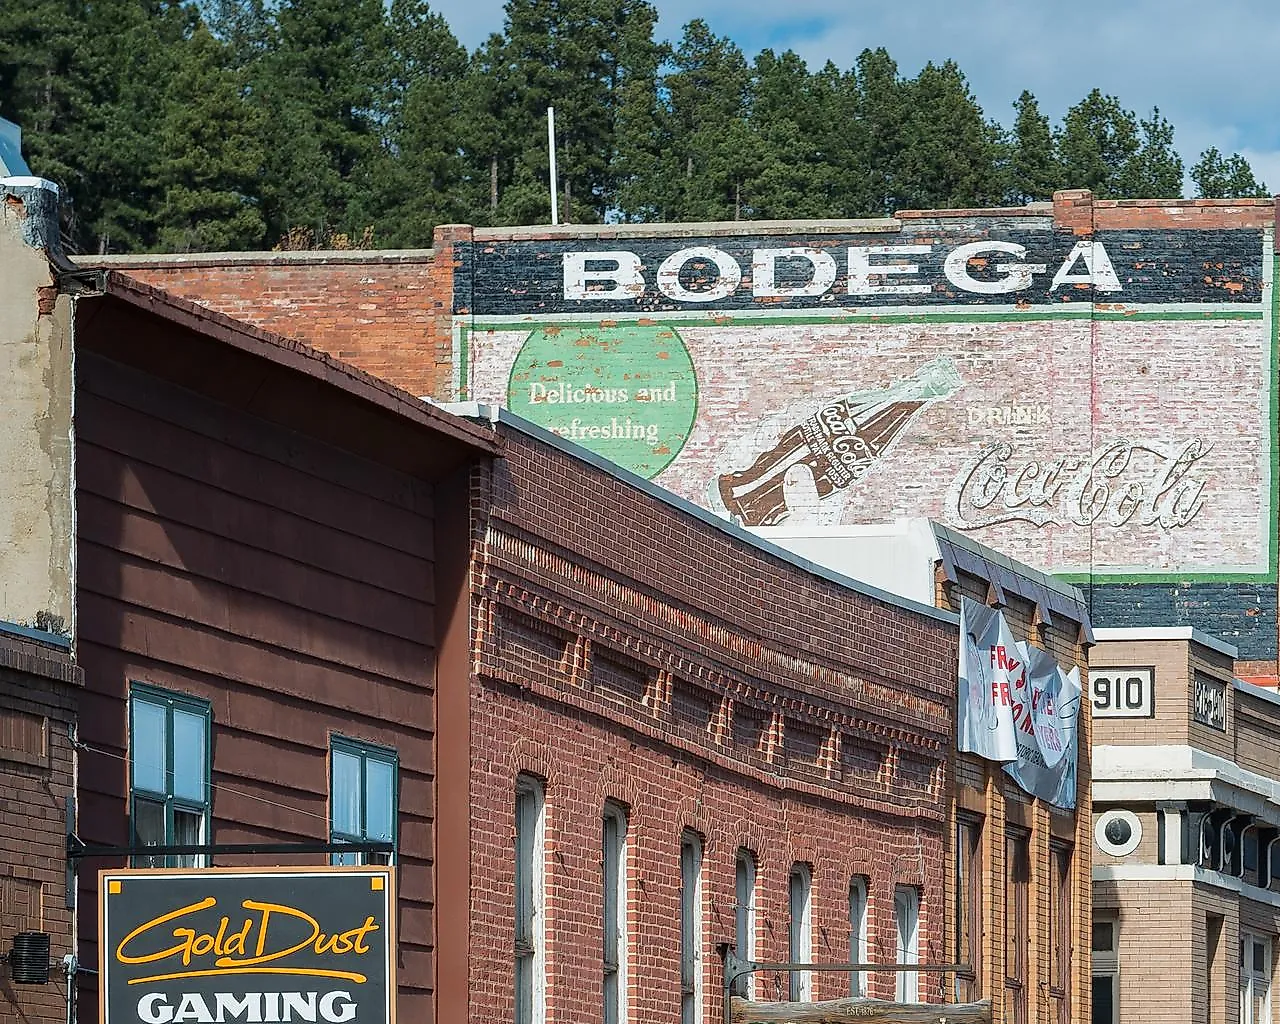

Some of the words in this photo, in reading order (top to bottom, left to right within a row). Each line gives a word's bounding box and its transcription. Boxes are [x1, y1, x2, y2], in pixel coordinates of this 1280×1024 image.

[562, 240, 1123, 303] BODEGA
[528, 382, 629, 405] Delicious
[636, 381, 677, 403] and
[966, 404, 1051, 426] DRINK
[116, 896, 252, 966] Gold
[216, 899, 380, 967] Dust
[137, 991, 358, 1024] GAMING
